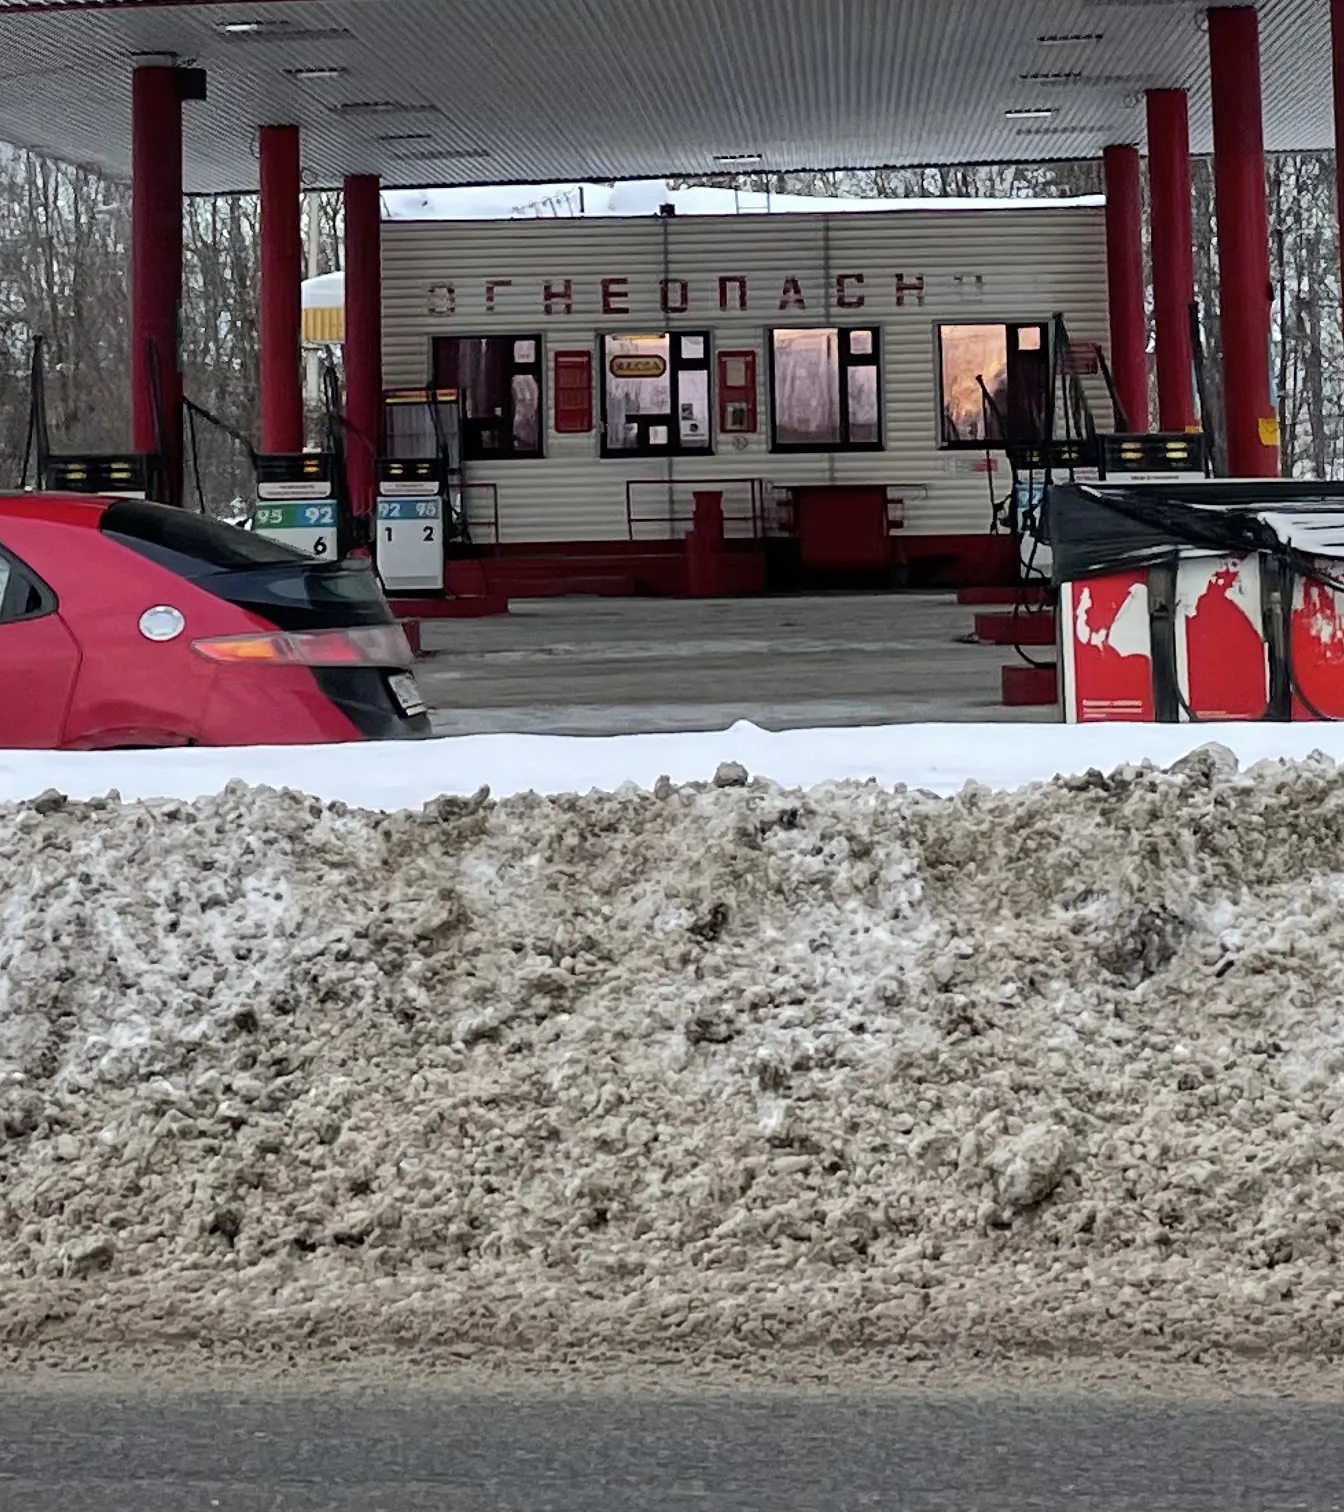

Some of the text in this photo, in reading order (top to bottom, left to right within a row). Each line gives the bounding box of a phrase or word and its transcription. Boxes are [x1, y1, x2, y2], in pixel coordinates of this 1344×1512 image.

[257, 507, 334, 524] 95 92
[378, 503, 401, 517] 92
[385, 525, 434, 542] 1 2
[313, 536, 327, 555] 6
